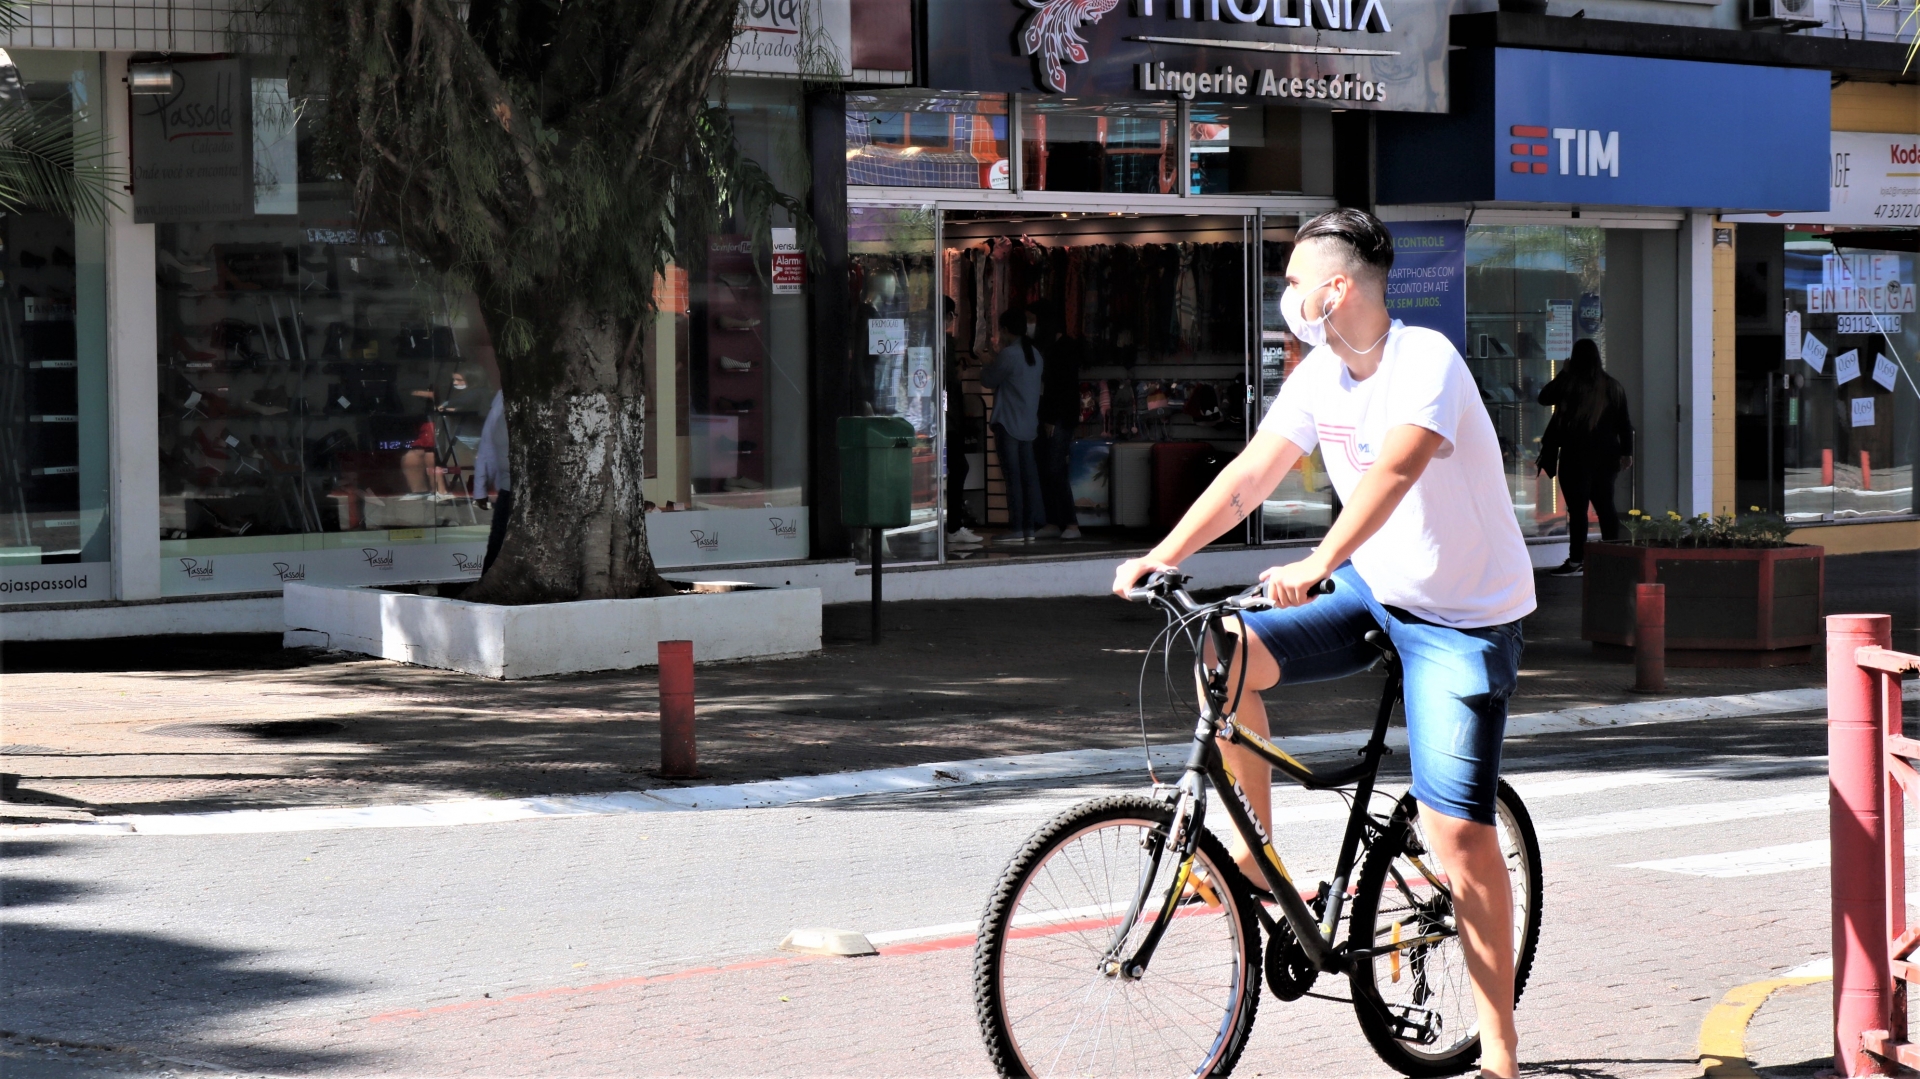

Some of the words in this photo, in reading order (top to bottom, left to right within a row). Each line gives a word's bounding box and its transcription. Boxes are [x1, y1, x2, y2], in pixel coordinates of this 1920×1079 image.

[1143, 62, 1248, 99] Lingerie
[1260, 69, 1388, 102] Acessórios
[137, 69, 234, 140] Passold
[1552, 127, 1620, 178] TIM
[134, 166, 160, 180] Onde
[1830, 152, 1851, 188] GE
[1874, 204, 1888, 218] 47
[1888, 204, 1913, 218] 3372
[1397, 236, 1445, 248] CONTROLE
[1437, 266, 1455, 277] COM
[1423, 282, 1434, 293] EM
[1435, 278, 1449, 292] ATÉ
[1397, 298, 1413, 308] SEM
[1414, 297, 1442, 308] JUROS.
[1811, 286, 1915, 311] ENTREGA
[1837, 353, 1857, 372] 0,69
[1876, 359, 1896, 378] 0,69
[1853, 401, 1873, 416] 0,69
[769, 517, 797, 535] Passold
[690, 529, 719, 549] Passold
[362, 547, 394, 567] Passold
[452, 552, 483, 572] Passold
[180, 557, 214, 578] Passold
[272, 562, 305, 582] Passold
